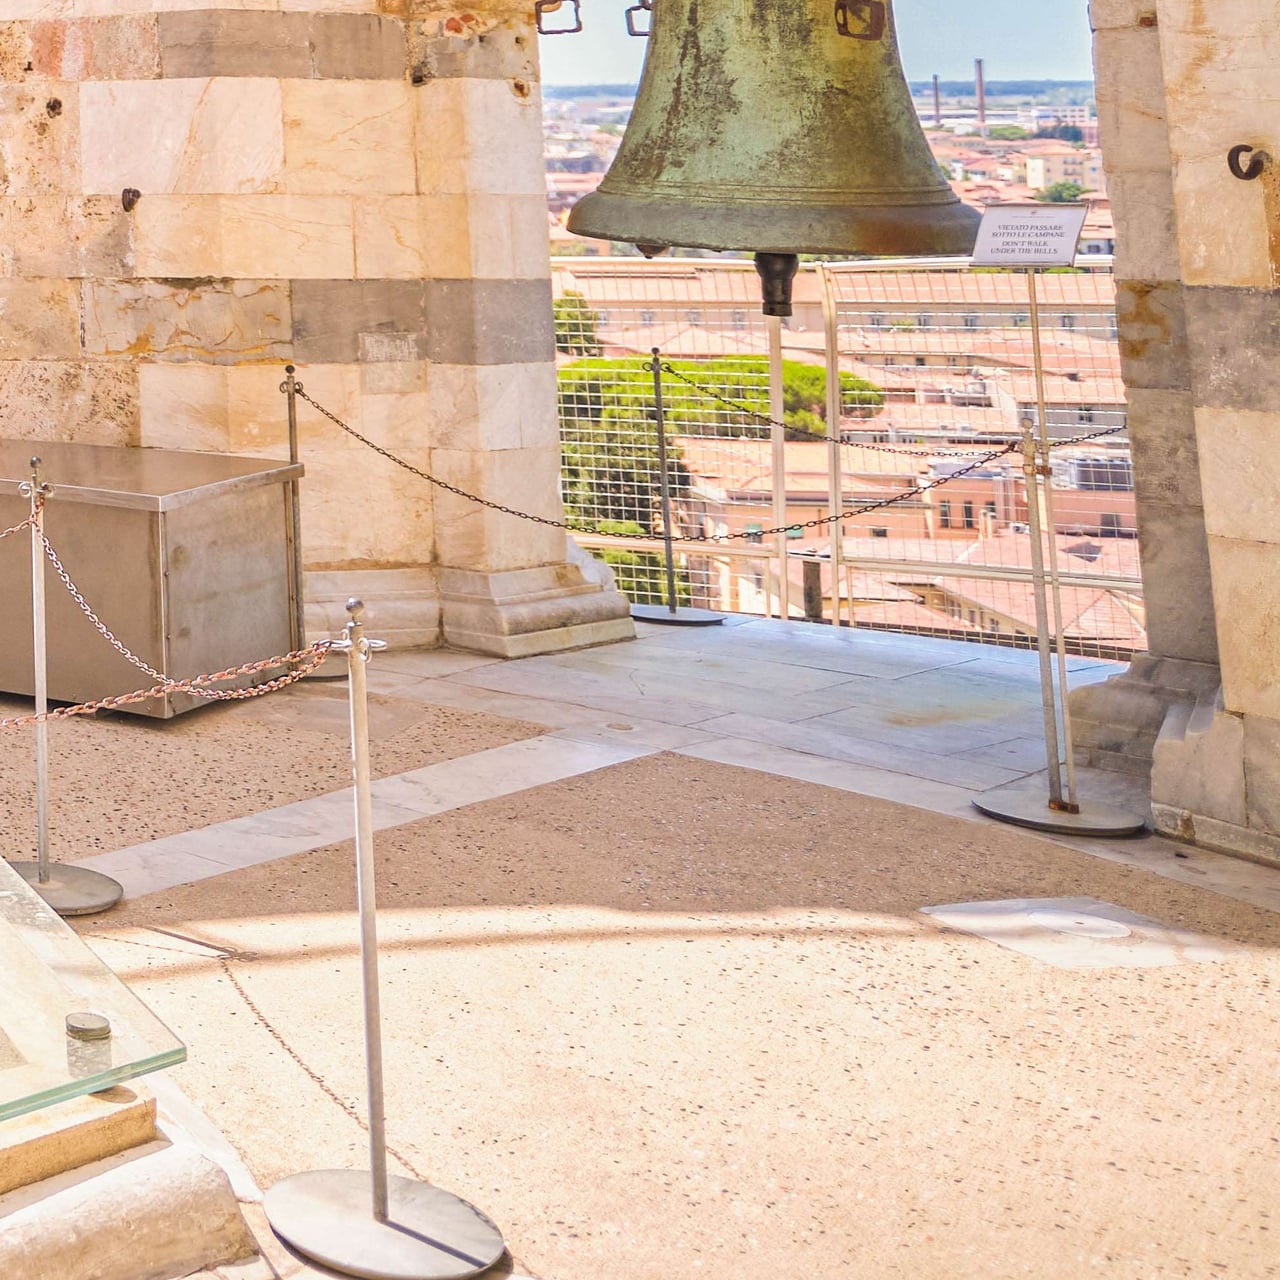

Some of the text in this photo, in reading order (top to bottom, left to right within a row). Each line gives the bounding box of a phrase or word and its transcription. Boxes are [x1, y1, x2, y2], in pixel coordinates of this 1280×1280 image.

[990, 247, 1058, 255] UNDER THE BELLS
